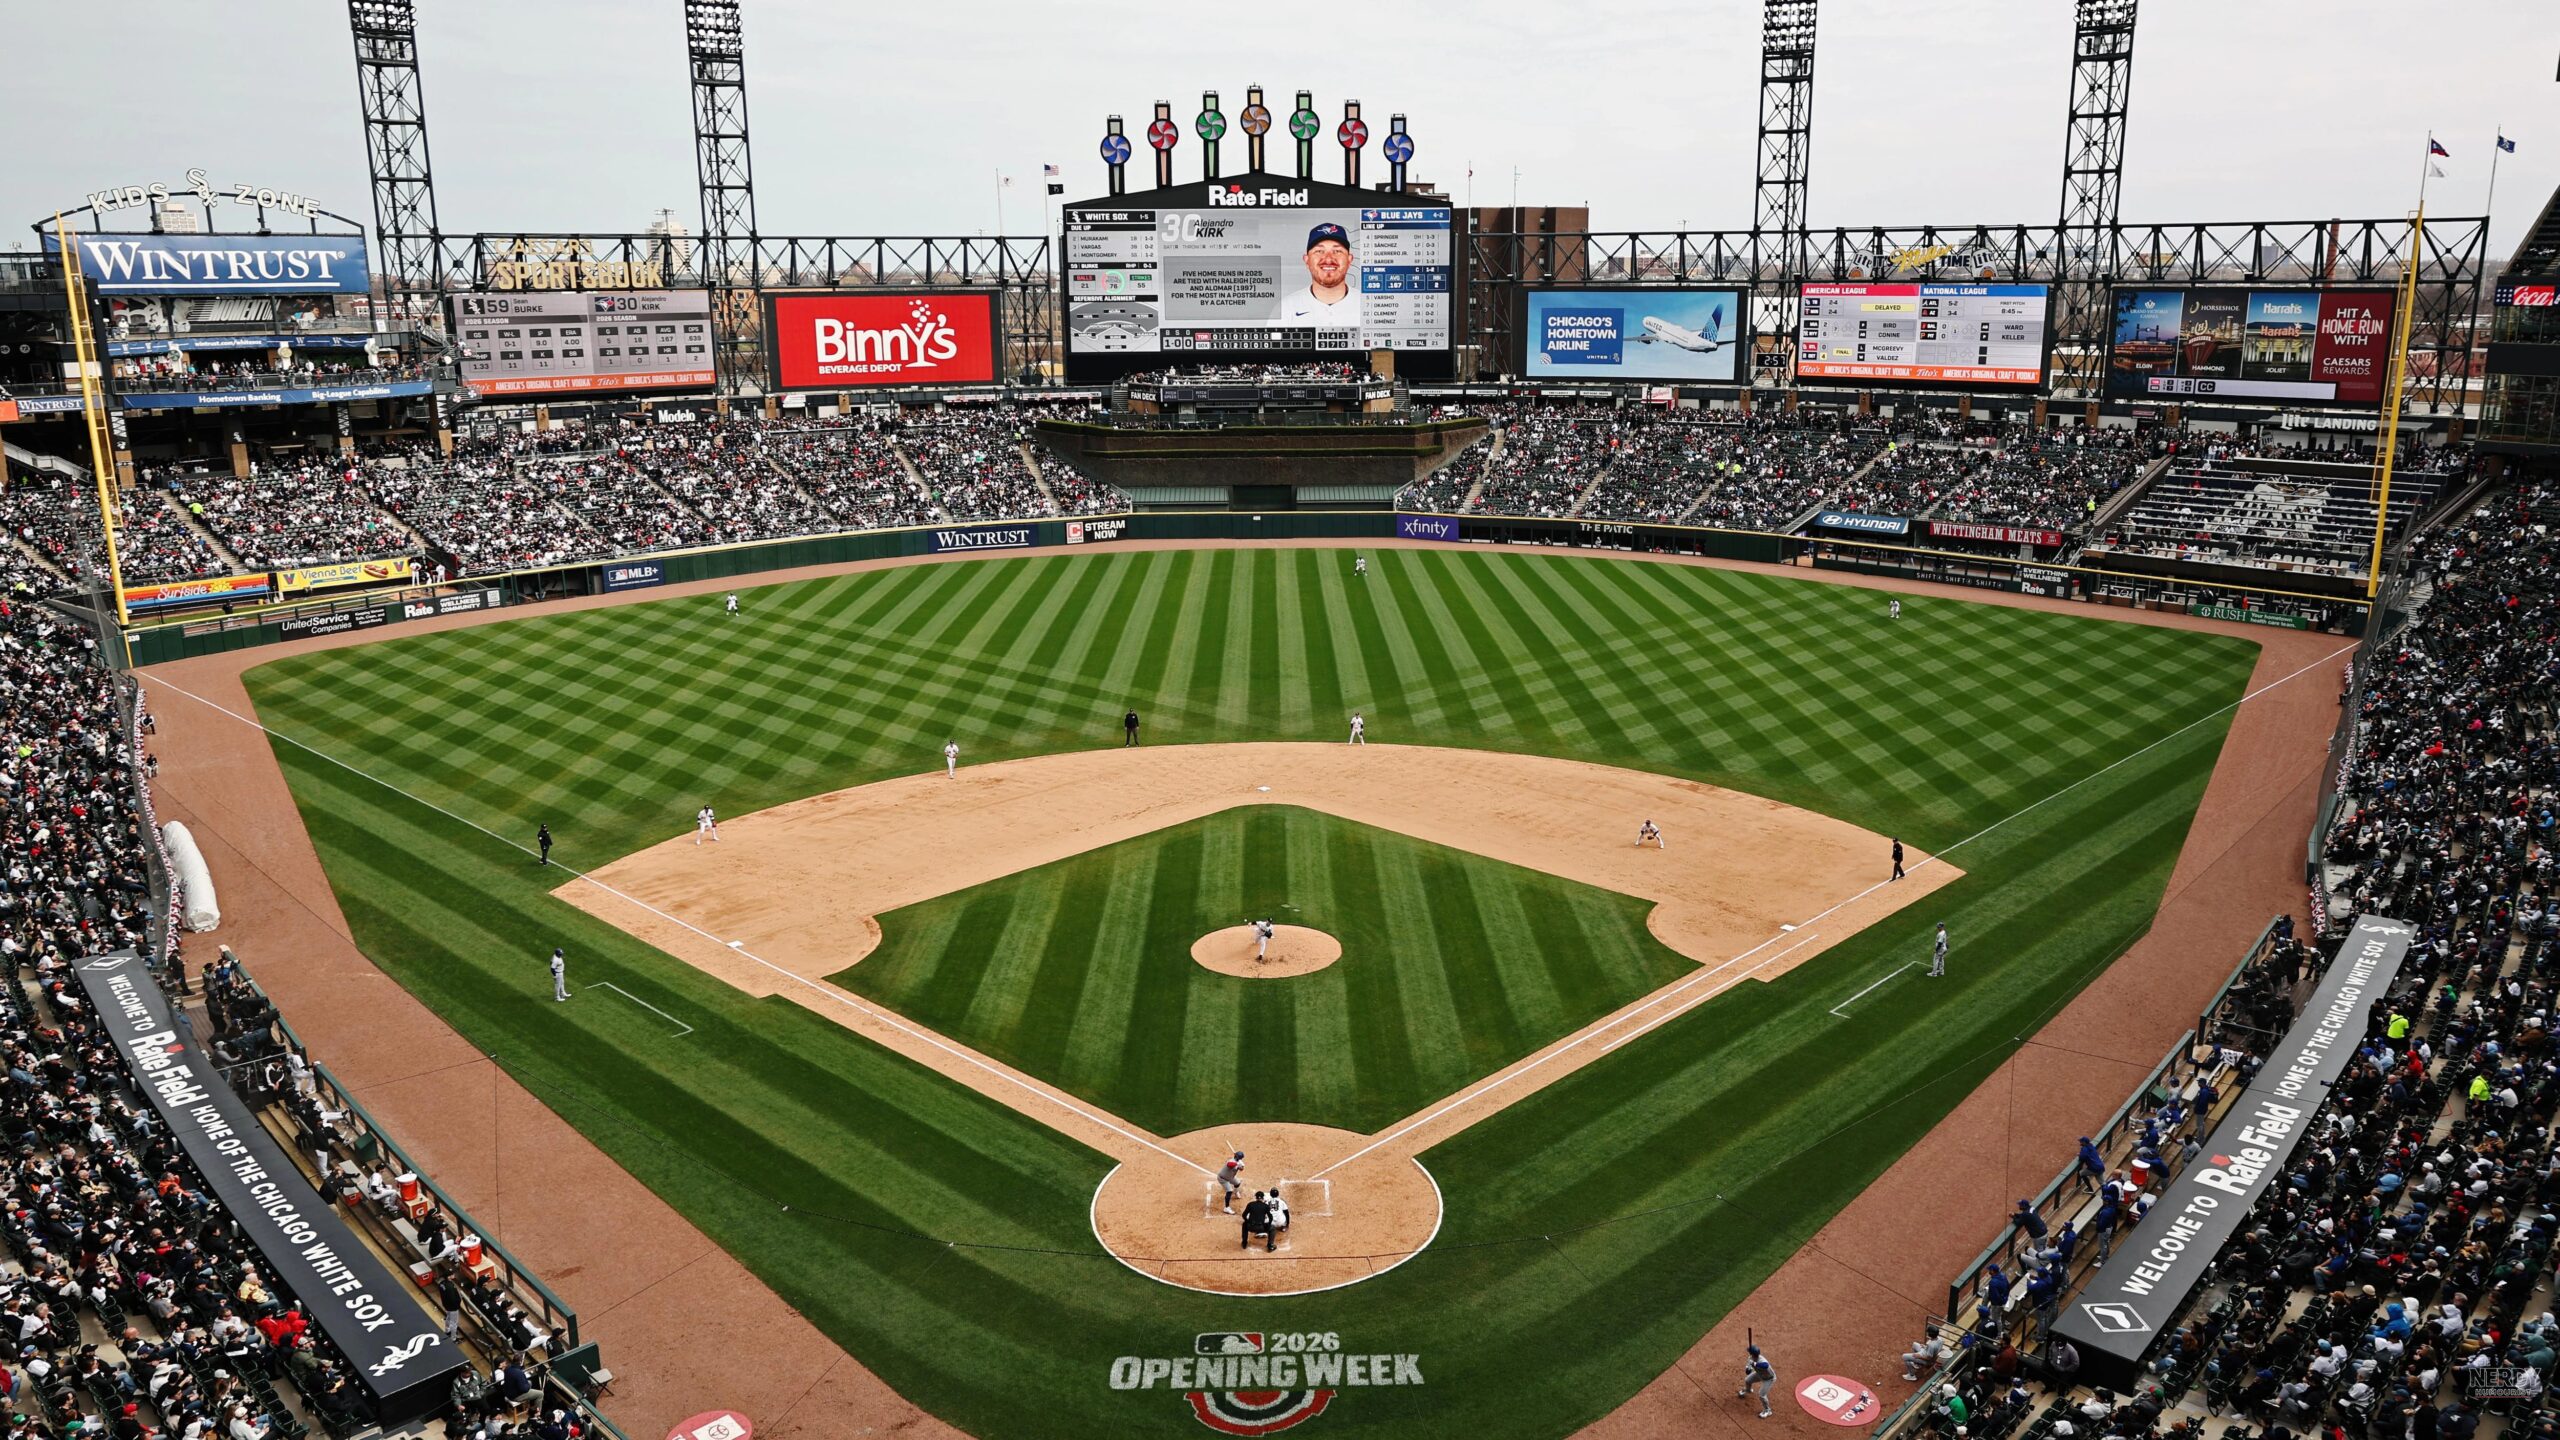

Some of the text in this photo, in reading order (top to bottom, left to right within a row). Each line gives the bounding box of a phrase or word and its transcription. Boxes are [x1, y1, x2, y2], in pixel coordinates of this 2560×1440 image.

[87, 182, 321, 220] KIDS ZONE
[1208, 184, 1309, 206] Rate Field
[1085, 213, 1129, 221] WHITE SOX
[1380, 211, 1424, 219] BLUE JAYS
[1161, 213, 1202, 242] 30
[1193, 218, 1235, 229] Alejandro
[1195, 227, 1225, 238] KIRK
[495, 238, 593, 256] CAESARS
[1941, 254, 1971, 268] TIME
[496, 261, 665, 290] SPORTSBOOK
[1805, 287, 1867, 295] AMERICAN LEAGUE
[1923, 287, 1959, 295] NATIONAL
[487, 299, 509, 313] 59
[514, 305, 543, 313] BURKE
[617, 297, 638, 310] 30
[641, 303, 661, 311] KIRK
[2200, 304, 2240, 312] HORSESHOE
[2336, 307, 2372, 319] HIT A
[483, 317, 509, 325] SEASON
[1547, 316, 1613, 327] CHICAGO'S
[2320, 318, 2384, 336] HOME RUN
[1547, 328, 1617, 339] HOMETOWN
[2333, 334, 2369, 346] WITH
[1547, 340, 1590, 351] AIRLINE
[2191, 364, 2226, 372] HAMMOND
[2322, 357, 2372, 367] CAESARS
[818, 363, 903, 375] BEVERAGE DEPOT
[2322, 366, 2371, 376] REWARDS
[198, 393, 282, 404] Hometown Banking
[311, 386, 392, 399] Big-League Capabilities
[1130, 391, 1157, 401] FAN DECK
[1365, 389, 1391, 400] FAN DECK
[18, 399, 82, 410] WINTRUST
[657, 408, 696, 424] Modelo
[2313, 416, 2378, 431] LANDING
[1084, 519, 1126, 533] STREAM
[1404, 520, 1449, 539] xfinity
[1843, 517, 1902, 531] HYUNDAI
[936, 529, 1030, 547] WINTRUST
[1093, 528, 1118, 540] NOW
[1932, 521, 2004, 541] WHITTINGHAM
[2007, 529, 2043, 544] MEATS
[300, 564, 362, 580] Vienna Beef
[628, 566, 659, 579] MLB+
[2023, 567, 2069, 578] EVERYTHING
[2023, 572, 2062, 583] WELLNESS
[157, 584, 208, 601] Surfside
[2021, 581, 2046, 595] Rate
[439, 595, 481, 609] WELLNESS
[440, 601, 481, 614] COMMUNITY
[404, 601, 434, 618] Rate
[2213, 609, 2247, 622] RUSH
[281, 613, 350, 631] UnitedService
[2250, 612, 2293, 623] Your hometown
[2250, 617, 2267, 625] health
[311, 621, 353, 634] Companies
[2120, 939, 2389, 1296] WELCOME TO Rate Field HOME OF THE CHICAGO WHITE SOX
[106, 973, 395, 1333] WELCOME TO Rate Field HOME OF THE CHICAGO WHITE SOX
[1269, 1331, 1341, 1353] 2026
[1108, 1353, 1425, 1391] OPENING WEEK
